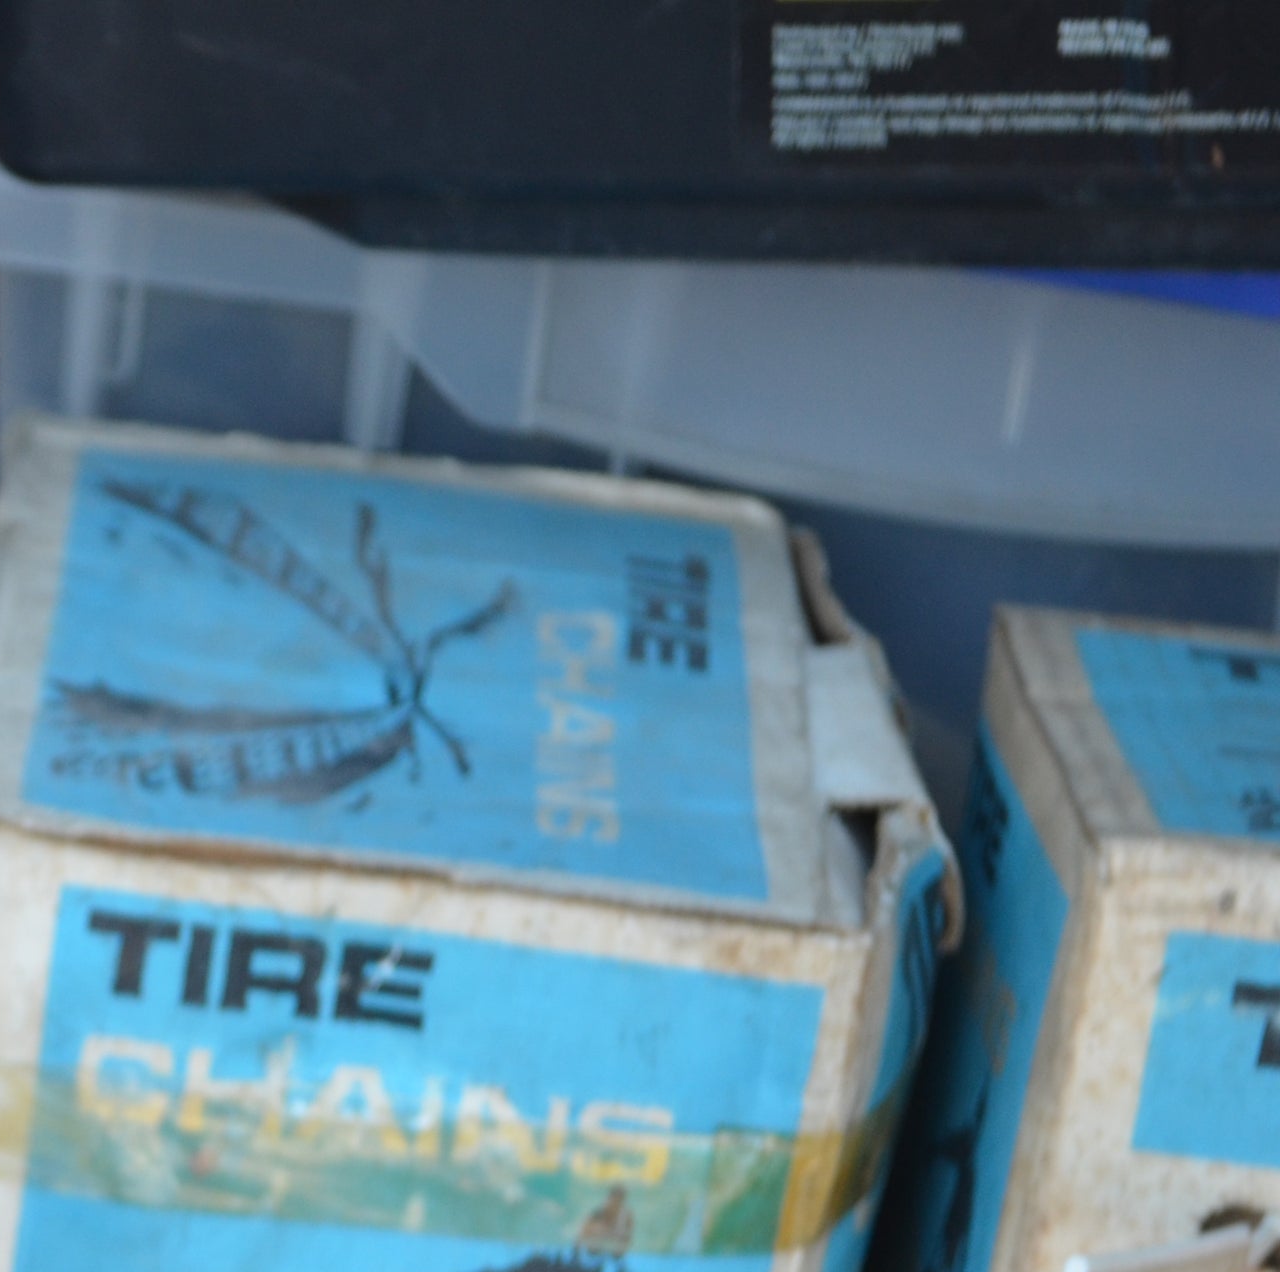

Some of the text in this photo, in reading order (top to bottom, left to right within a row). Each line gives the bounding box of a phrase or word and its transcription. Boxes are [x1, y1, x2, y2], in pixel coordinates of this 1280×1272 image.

[625, 552, 714, 678] TIRE
[534, 609, 622, 846] CHAINS
[86, 908, 438, 1033] TIRE
[73, 1033, 677, 1185] CHAINS
